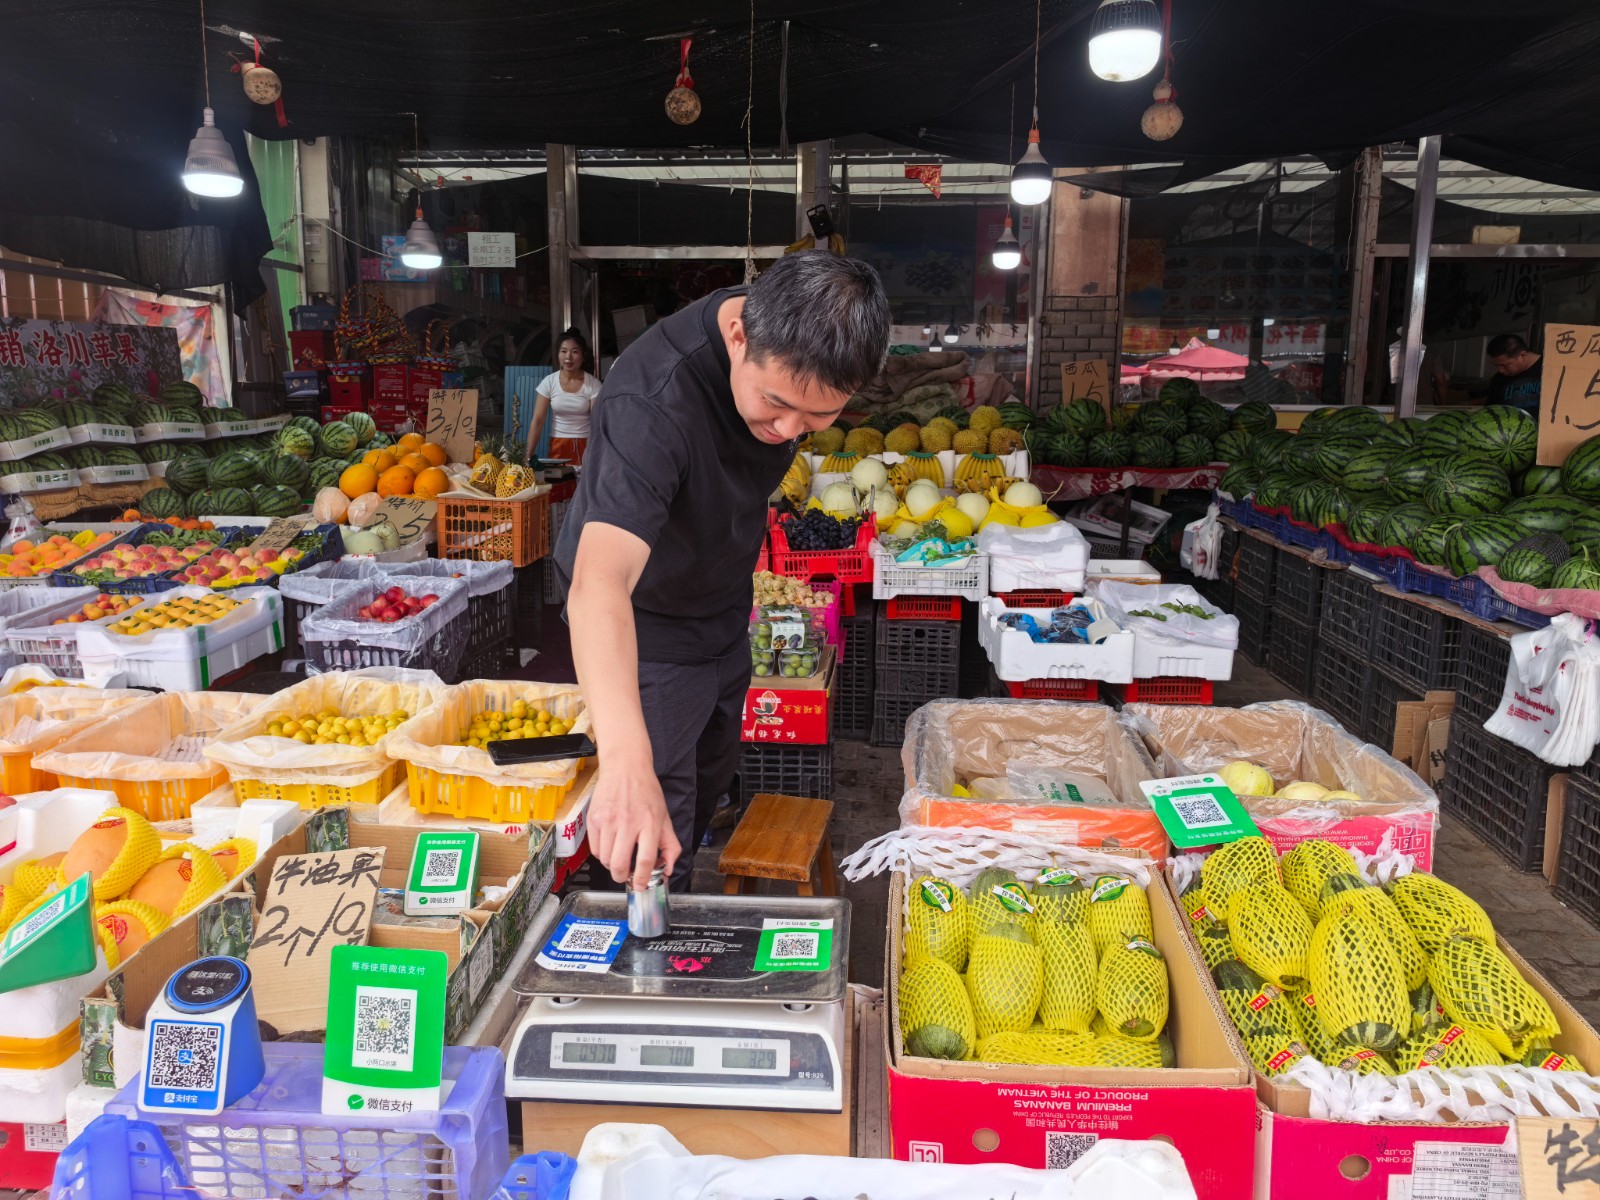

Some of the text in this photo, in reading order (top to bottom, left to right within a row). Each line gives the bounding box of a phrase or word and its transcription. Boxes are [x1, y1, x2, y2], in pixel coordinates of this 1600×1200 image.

[481, 234, 501, 244] 招工
[33, 329, 141, 369] 洛川苹果
[1065, 361, 1099, 377] 西瓜
[432, 390, 467, 404] 特价
[388, 496, 425, 513] 特价
[1403, 838, 1410, 848] 5
[1415, 837, 1424, 847] 4
[275, 853, 382, 895] 牛油果
[351, 961, 426, 976] 推荐使用微信支付
[175, 1093, 198, 1104] 支付宝
[997, 1088, 1149, 1100] VIETNAM THE OF PRODUCT
[367, 1097, 413, 1113] 微信支付
[1013, 1099, 1132, 1112] BANANAS PREMIUM
[1025, 1118, 1119, 1130] 输往中华人民共和国
[915, 1148, 937, 1163] CL
